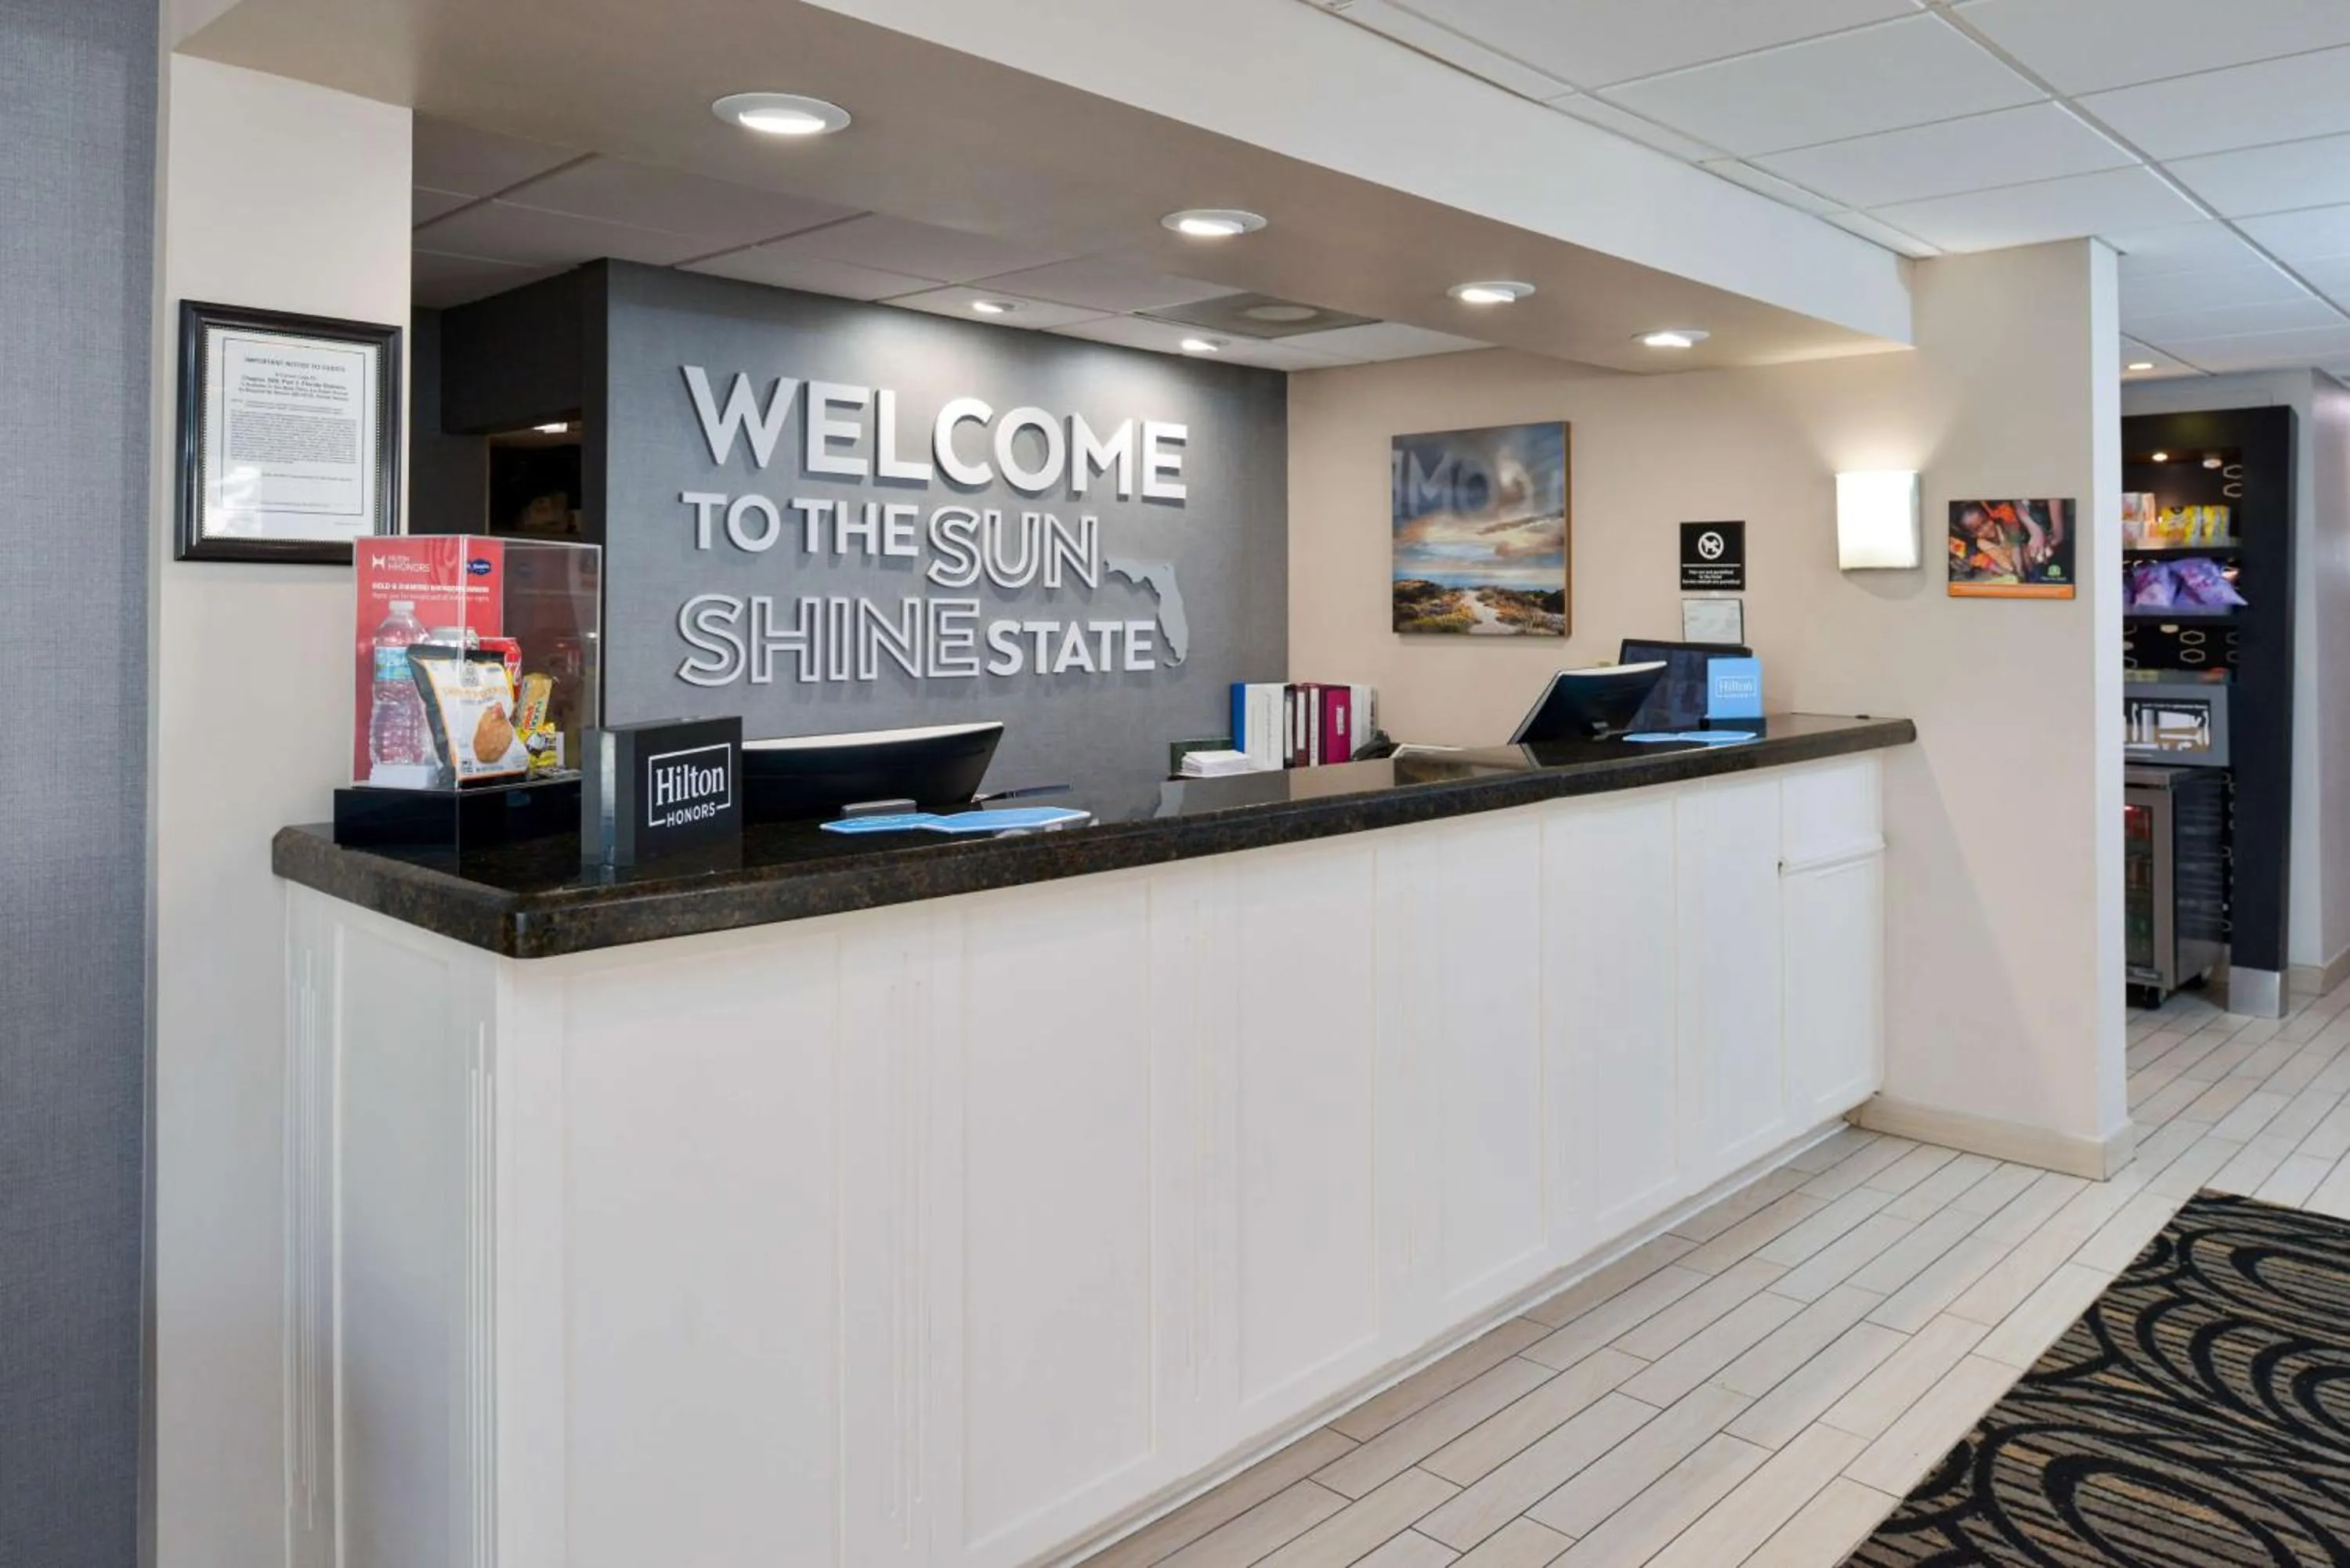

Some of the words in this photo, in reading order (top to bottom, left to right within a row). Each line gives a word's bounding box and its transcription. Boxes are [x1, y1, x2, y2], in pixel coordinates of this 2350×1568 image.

[679, 365, 1188, 501] WELCOME
[680, 491, 781, 553] TO
[790, 497, 920, 558] THE
[926, 504, 1098, 590] SUN
[676, 593, 981, 688] SHINE
[985, 619, 1157, 677] STATE
[1719, 680, 1753, 693] Hilton
[656, 763, 725, 807] Hilton
[666, 800, 716, 828] HONORS
